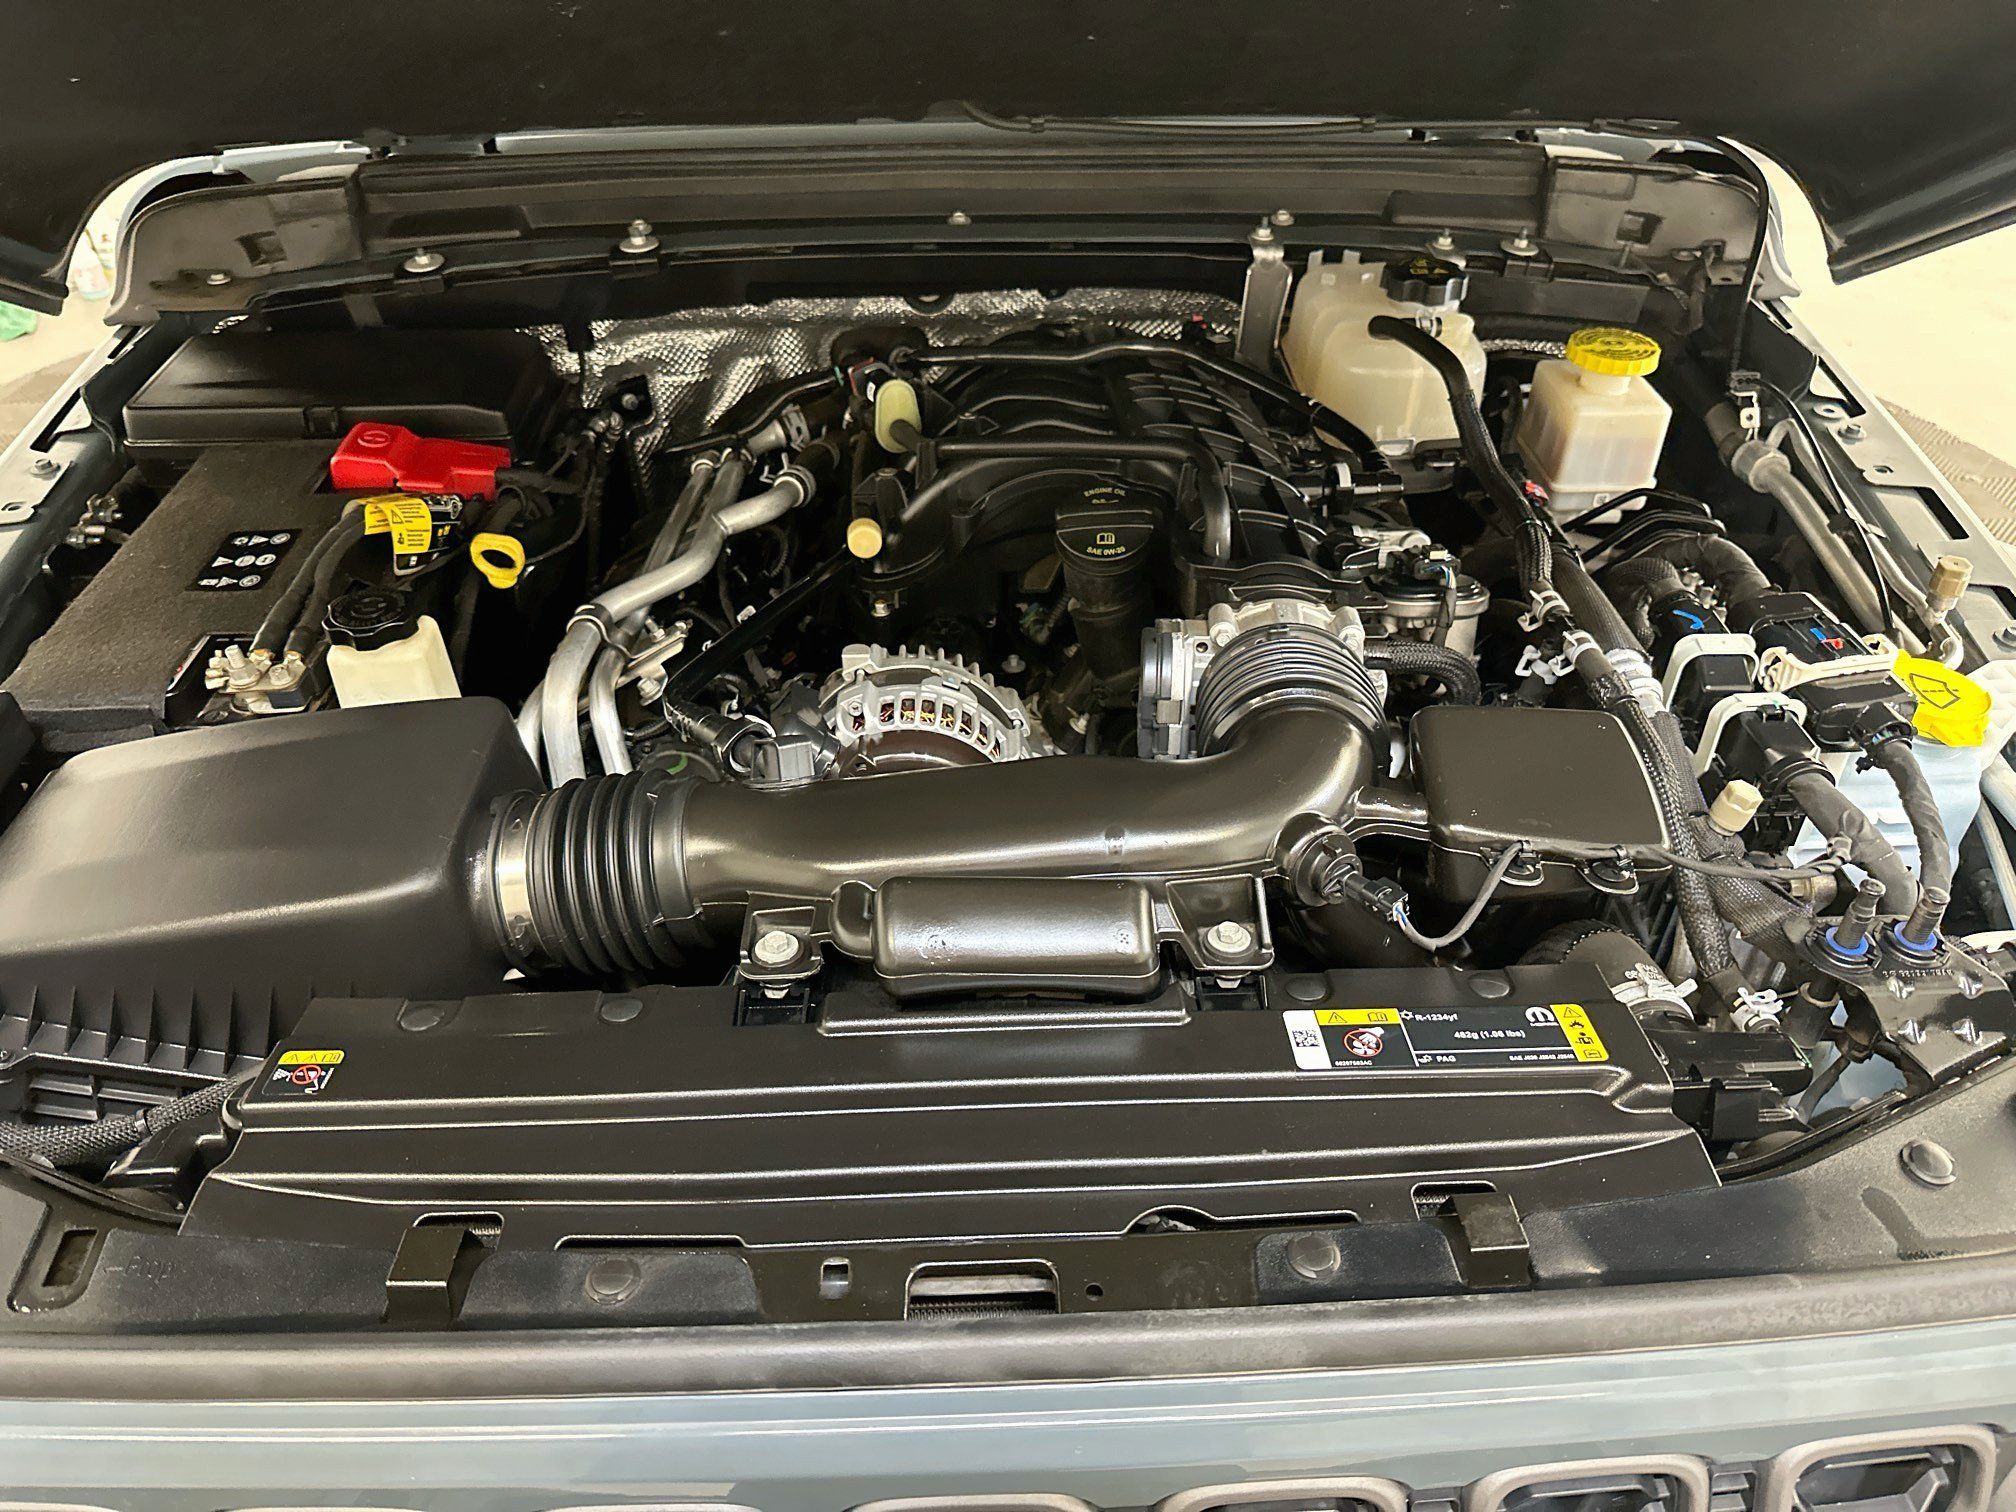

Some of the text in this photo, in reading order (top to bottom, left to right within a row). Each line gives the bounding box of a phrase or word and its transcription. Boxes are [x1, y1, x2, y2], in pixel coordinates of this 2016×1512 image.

[1084, 487, 1126, 497] ENGINE OIL
[1086, 546, 1102, 555] SAE
